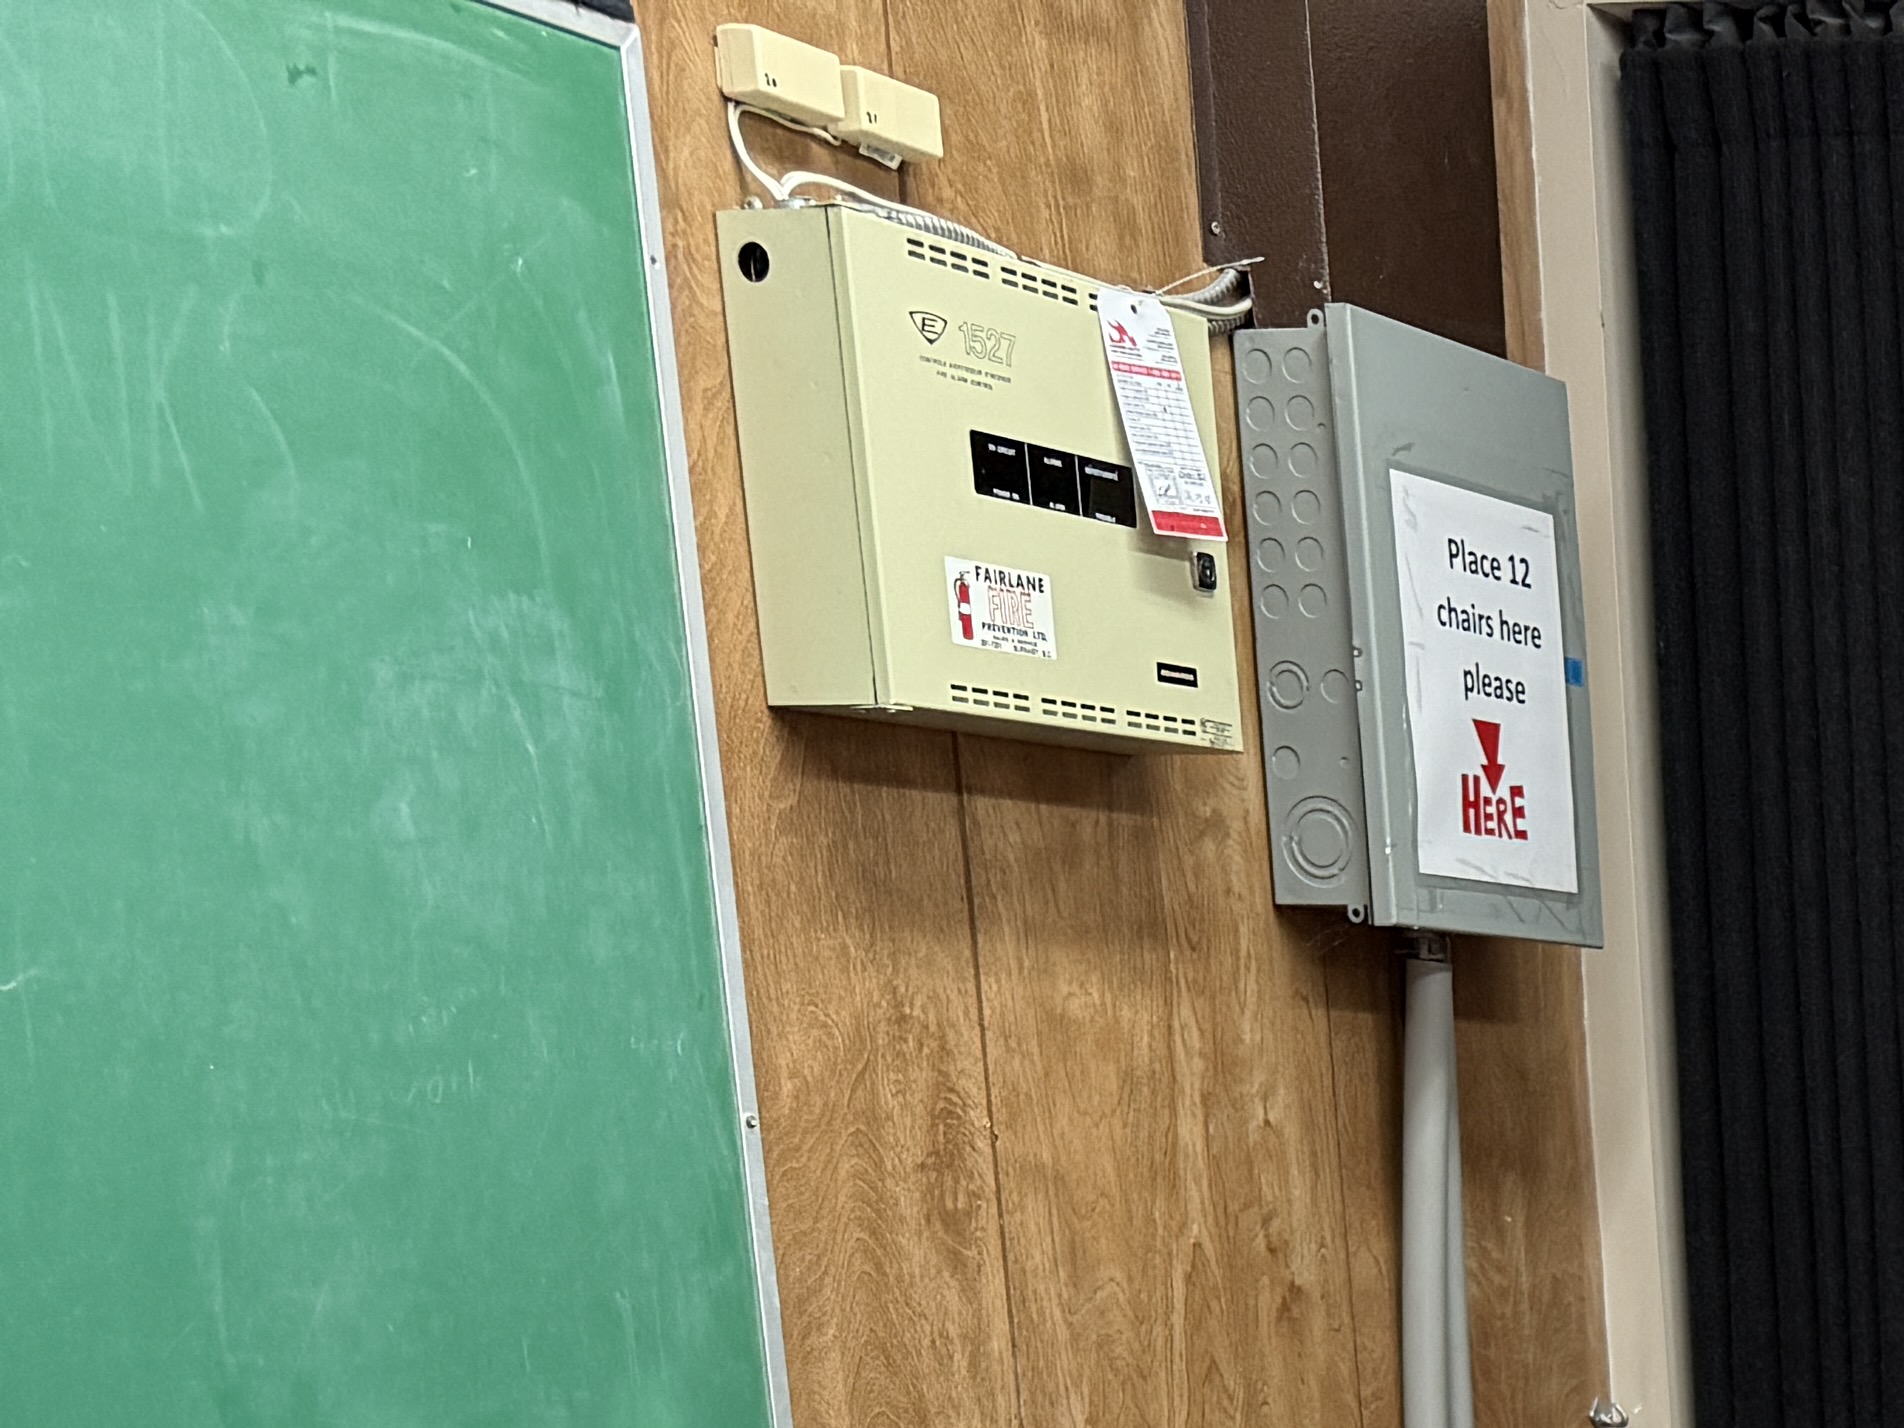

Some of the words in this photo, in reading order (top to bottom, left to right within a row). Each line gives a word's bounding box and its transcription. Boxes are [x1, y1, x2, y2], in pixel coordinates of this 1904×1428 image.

[958, 320, 1017, 368] 1527
[974, 564, 1045, 594] FAIRLANE
[1447, 537, 1502, 582] Place
[1508, 554, 1532, 590] 12
[981, 621, 1028, 638] PREVENTION
[987, 584, 1034, 630] FIRE
[1437, 596, 1494, 639] chairs
[1499, 609, 1542, 650] here
[1463, 662, 1526, 706] please
[1461, 773, 1529, 841] HERE
